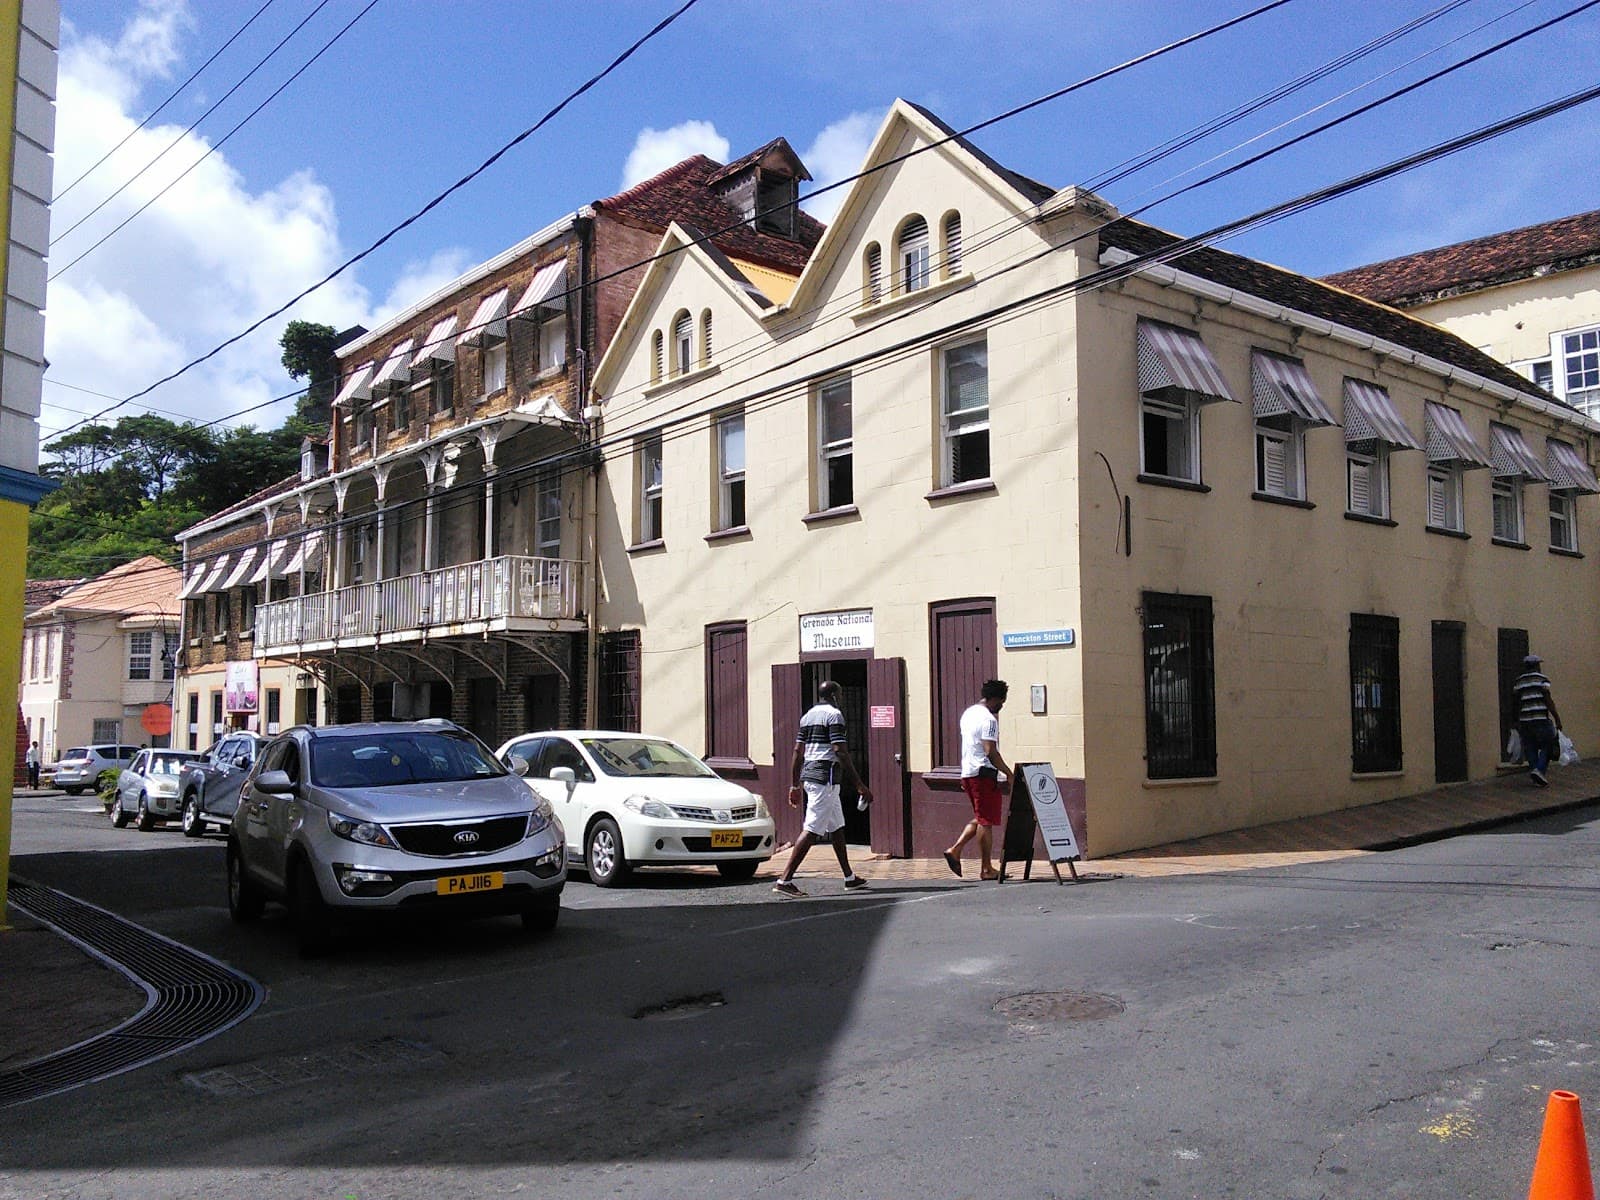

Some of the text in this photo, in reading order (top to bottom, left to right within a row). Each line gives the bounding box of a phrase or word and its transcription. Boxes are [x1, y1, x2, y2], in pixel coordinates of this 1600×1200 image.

[802, 611, 873, 629] Grenada National
[813, 633, 861, 649] Museum
[1043, 632, 1067, 641] Street
[457, 831, 476, 842] KIA
